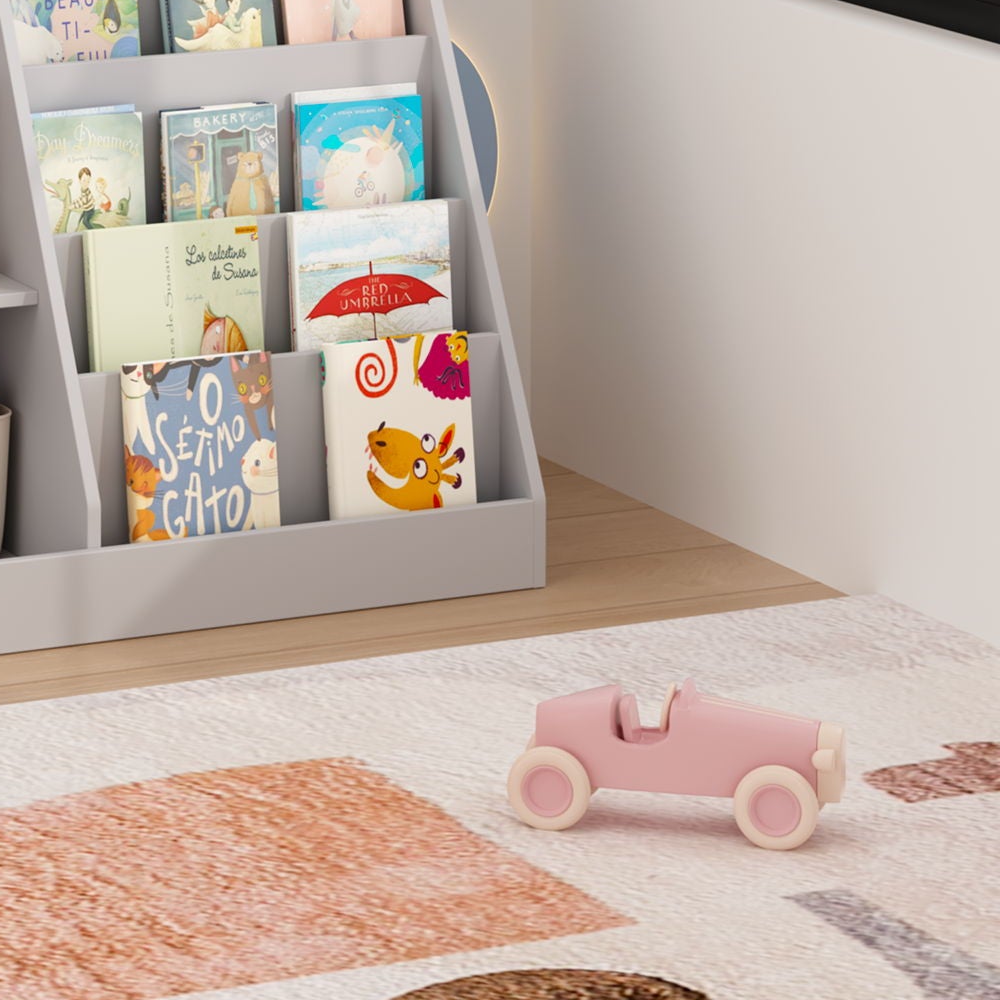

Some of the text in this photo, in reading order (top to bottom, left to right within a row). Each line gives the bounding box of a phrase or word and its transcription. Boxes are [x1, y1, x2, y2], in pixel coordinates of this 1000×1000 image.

[61, 21, 90, 40] TI-
[193, 112, 247, 128] BAKERY
[34, 130, 67, 160] Day
[185, 244, 247, 266] Los calcetines
[212, 262, 258, 280] de Susana
[362, 283, 388, 296] RED
[340, 292, 412, 310] UMBRELLA
[199, 373, 223, 426] O
[162, 472, 245, 539] GATO
